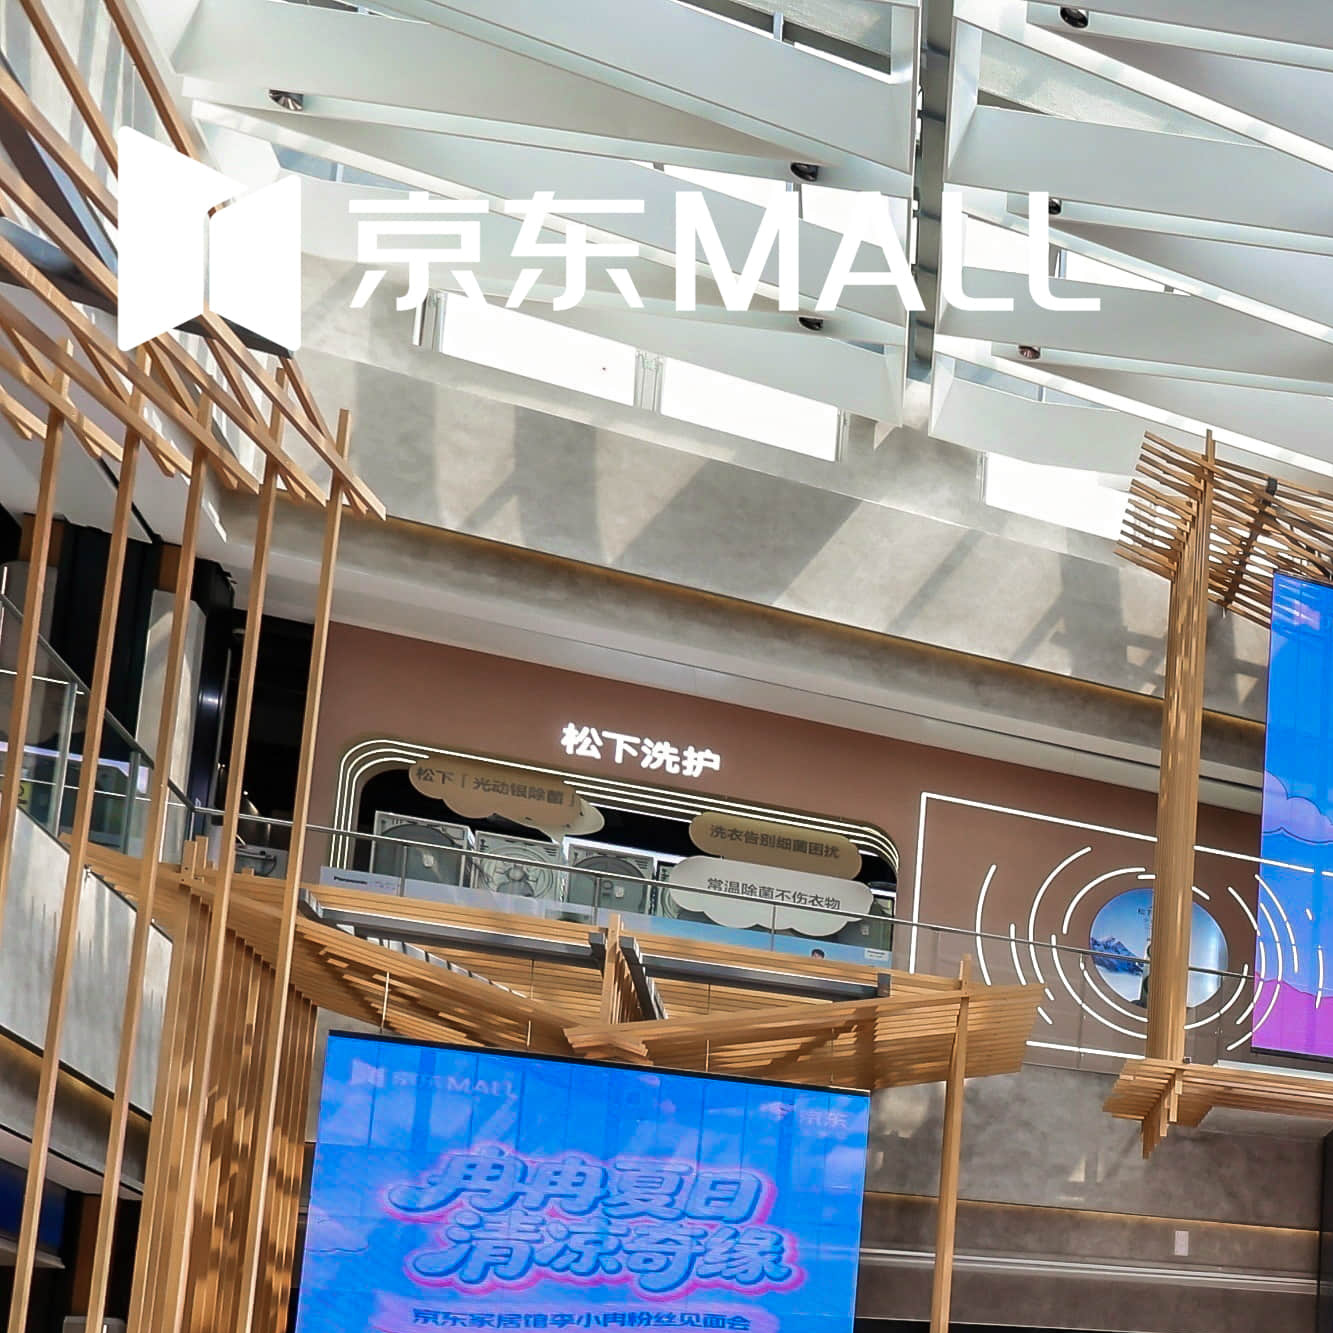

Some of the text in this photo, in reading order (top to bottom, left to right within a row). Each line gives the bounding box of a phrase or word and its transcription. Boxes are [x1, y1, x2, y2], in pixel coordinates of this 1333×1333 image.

[561, 722, 722, 779] 松下洗护
[709, 823, 841, 859] 洗衣告别细菌困扰
[706, 877, 841, 911] 常温除菌不伤衣物
[388, 1147, 765, 1225] 冉冉夏日
[412, 1209, 795, 1294] 清凉奇缘
[411, 1308, 752, 1333] 京东家居馆李小冉粉丝见面会
